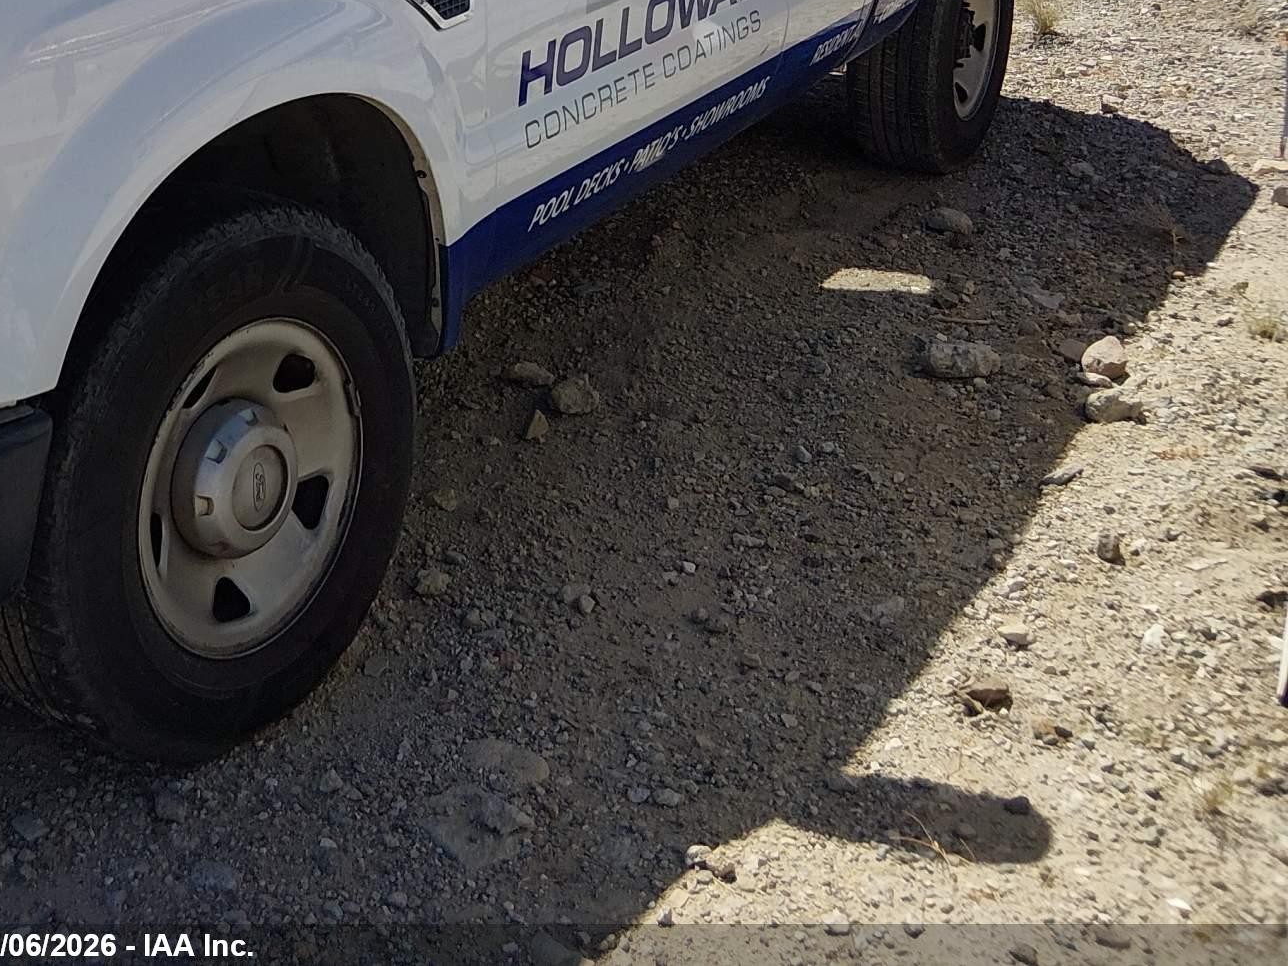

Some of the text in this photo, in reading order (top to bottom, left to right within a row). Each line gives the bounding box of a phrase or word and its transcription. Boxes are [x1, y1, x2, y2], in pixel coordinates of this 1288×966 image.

[525, 9, 762, 149] CONCRETE COATINGS
[527, 75, 771, 233] POOL DECKS PATIO'S SHOWROOMS
